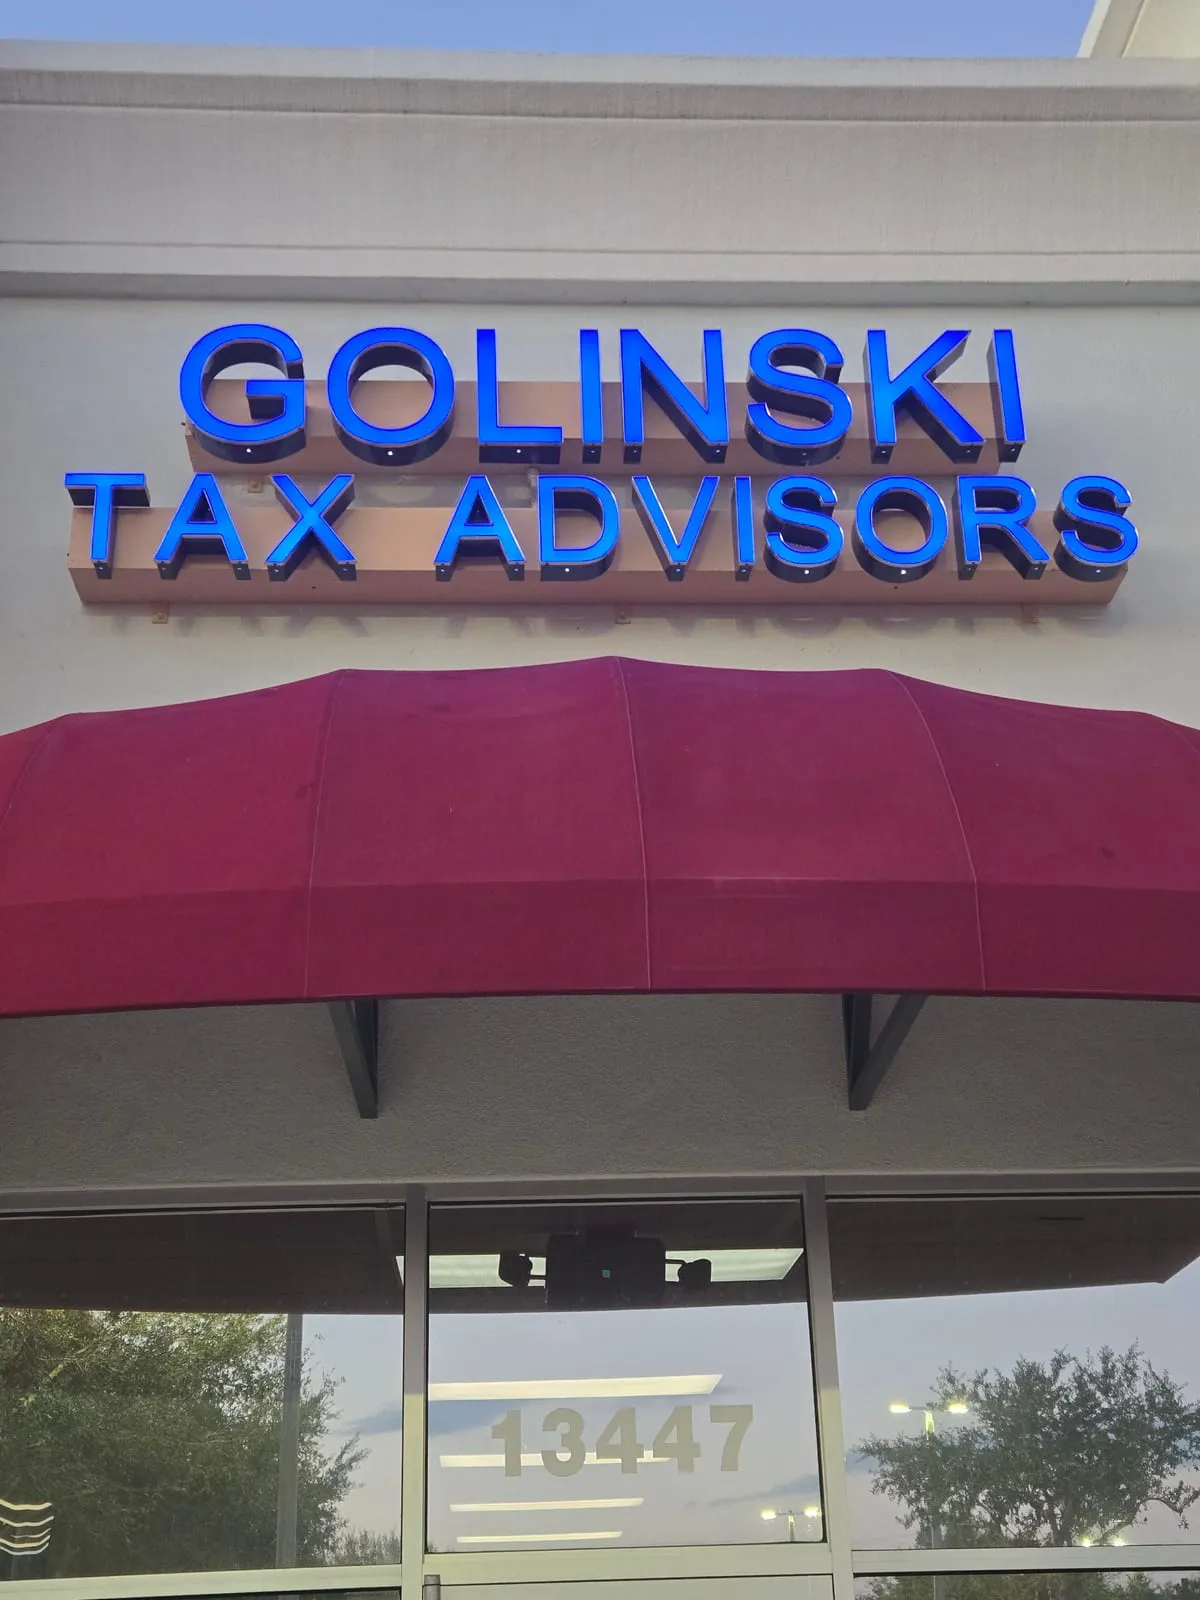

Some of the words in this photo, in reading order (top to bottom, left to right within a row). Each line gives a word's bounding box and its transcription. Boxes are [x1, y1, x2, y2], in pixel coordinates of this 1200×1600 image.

[179, 323, 1025, 446] GOLINSKI
[64, 472, 355, 564] TAX
[435, 474, 1139, 567] ADVISORS
[491, 1404, 754, 1477] 13447
